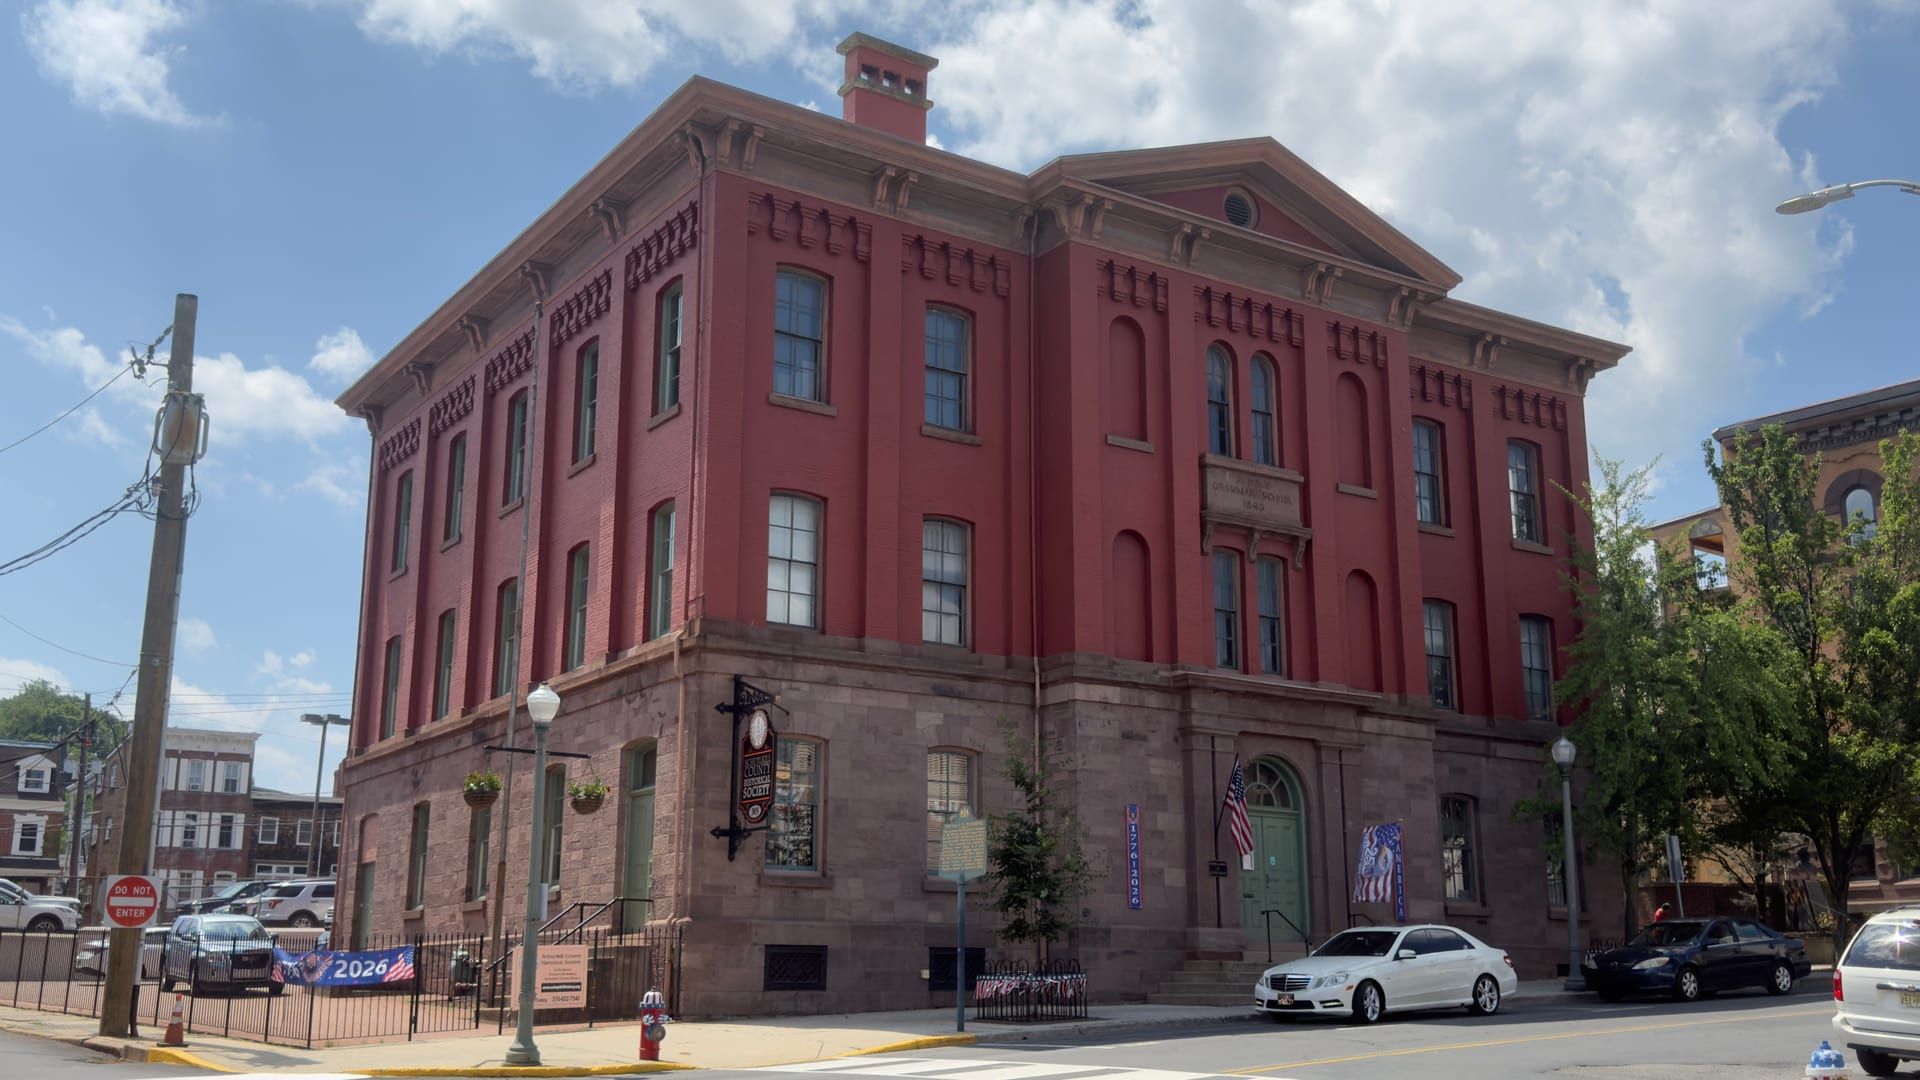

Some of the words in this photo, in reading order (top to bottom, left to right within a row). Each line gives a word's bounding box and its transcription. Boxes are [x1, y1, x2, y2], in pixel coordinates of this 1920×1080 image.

[1263, 491, 1294, 505] SCHOOL
[745, 764, 771, 777] COUNTY
[743, 784, 769, 799] SOCIETY
[1395, 843, 1405, 917] AMERICA
[115, 885, 128, 895] DO
[132, 886, 152, 895] NOT
[116, 908, 145, 917] ENTER
[334, 959, 389, 978] 2026
